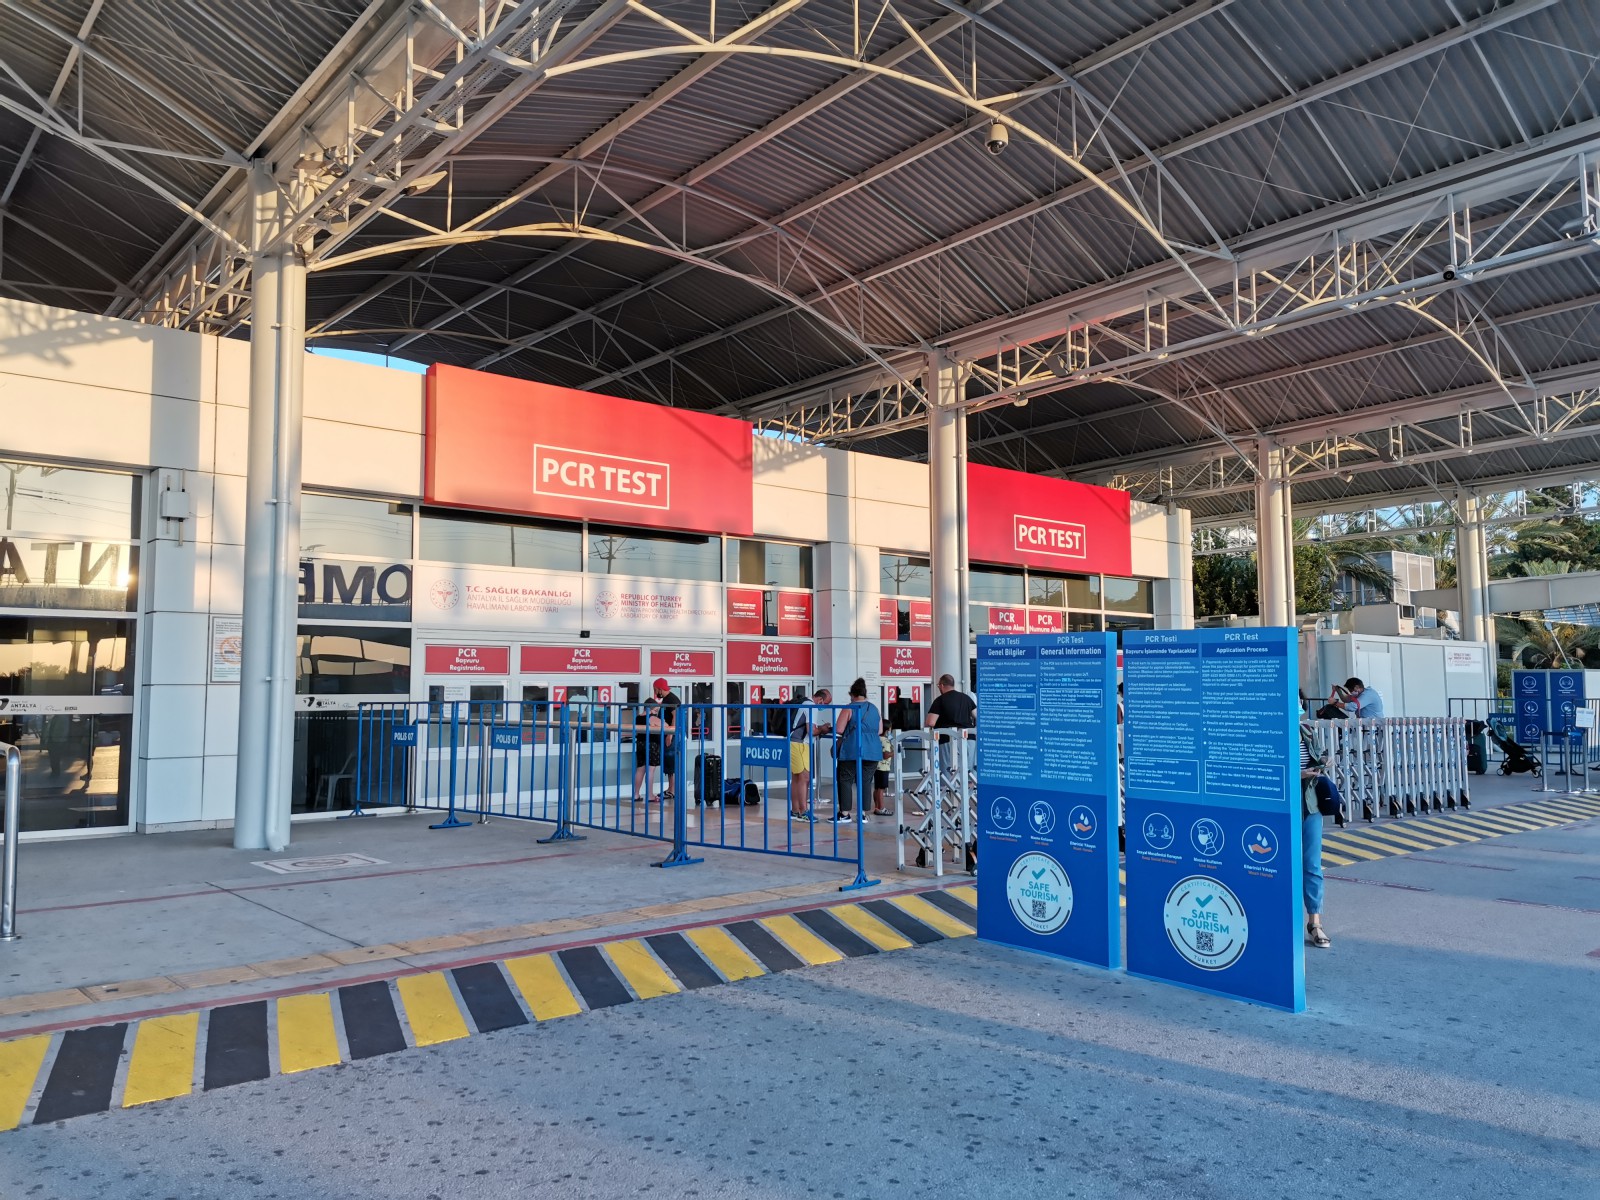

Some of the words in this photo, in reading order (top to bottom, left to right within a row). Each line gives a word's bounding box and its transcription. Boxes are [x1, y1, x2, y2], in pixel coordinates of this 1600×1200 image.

[543, 458, 595, 488] PCR
[600, 466, 661, 496] TEST
[1019, 524, 1047, 545] PCR
[1048, 528, 1081, 549] TEST
[466, 585, 482, 593] T.C.
[486, 586, 519, 594] SAĞLIK
[522, 589, 571, 597] BAKANLIĞI
[506, 595, 528, 603] SAĞLIK
[511, 605, 558, 613] LABORATUVARI
[999, 612, 1015, 623] PCR
[1038, 615, 1053, 625] PCR
[458, 648, 477, 657] PCR
[574, 649, 590, 657] PCR
[761, 644, 779, 655] PCR
[896, 648, 912, 658] PCR
[1005, 649, 1026, 657] Bilgiler
[675, 653, 689, 661] PCR
[758, 655, 782, 663] Başvuru
[752, 664, 788, 672] Registration
[555, 688, 564, 700] 7
[600, 689, 609, 701] 6
[752, 689, 759, 701] 4
[781, 689, 788, 701] 3
[889, 688, 895, 701] 2
[914, 689, 919, 700] 1
[512, 736, 518, 744] 07
[772, 749, 782, 760] 07
[1029, 881, 1050, 892] SAFE
[1181, 881, 1218, 891] CERTIFICATE
[1020, 888, 1058, 902] TOURISM
[1192, 909, 1218, 922] SAFE
[1181, 917, 1229, 934] TOURISM
[1194, 955, 1217, 964] TURKEY
